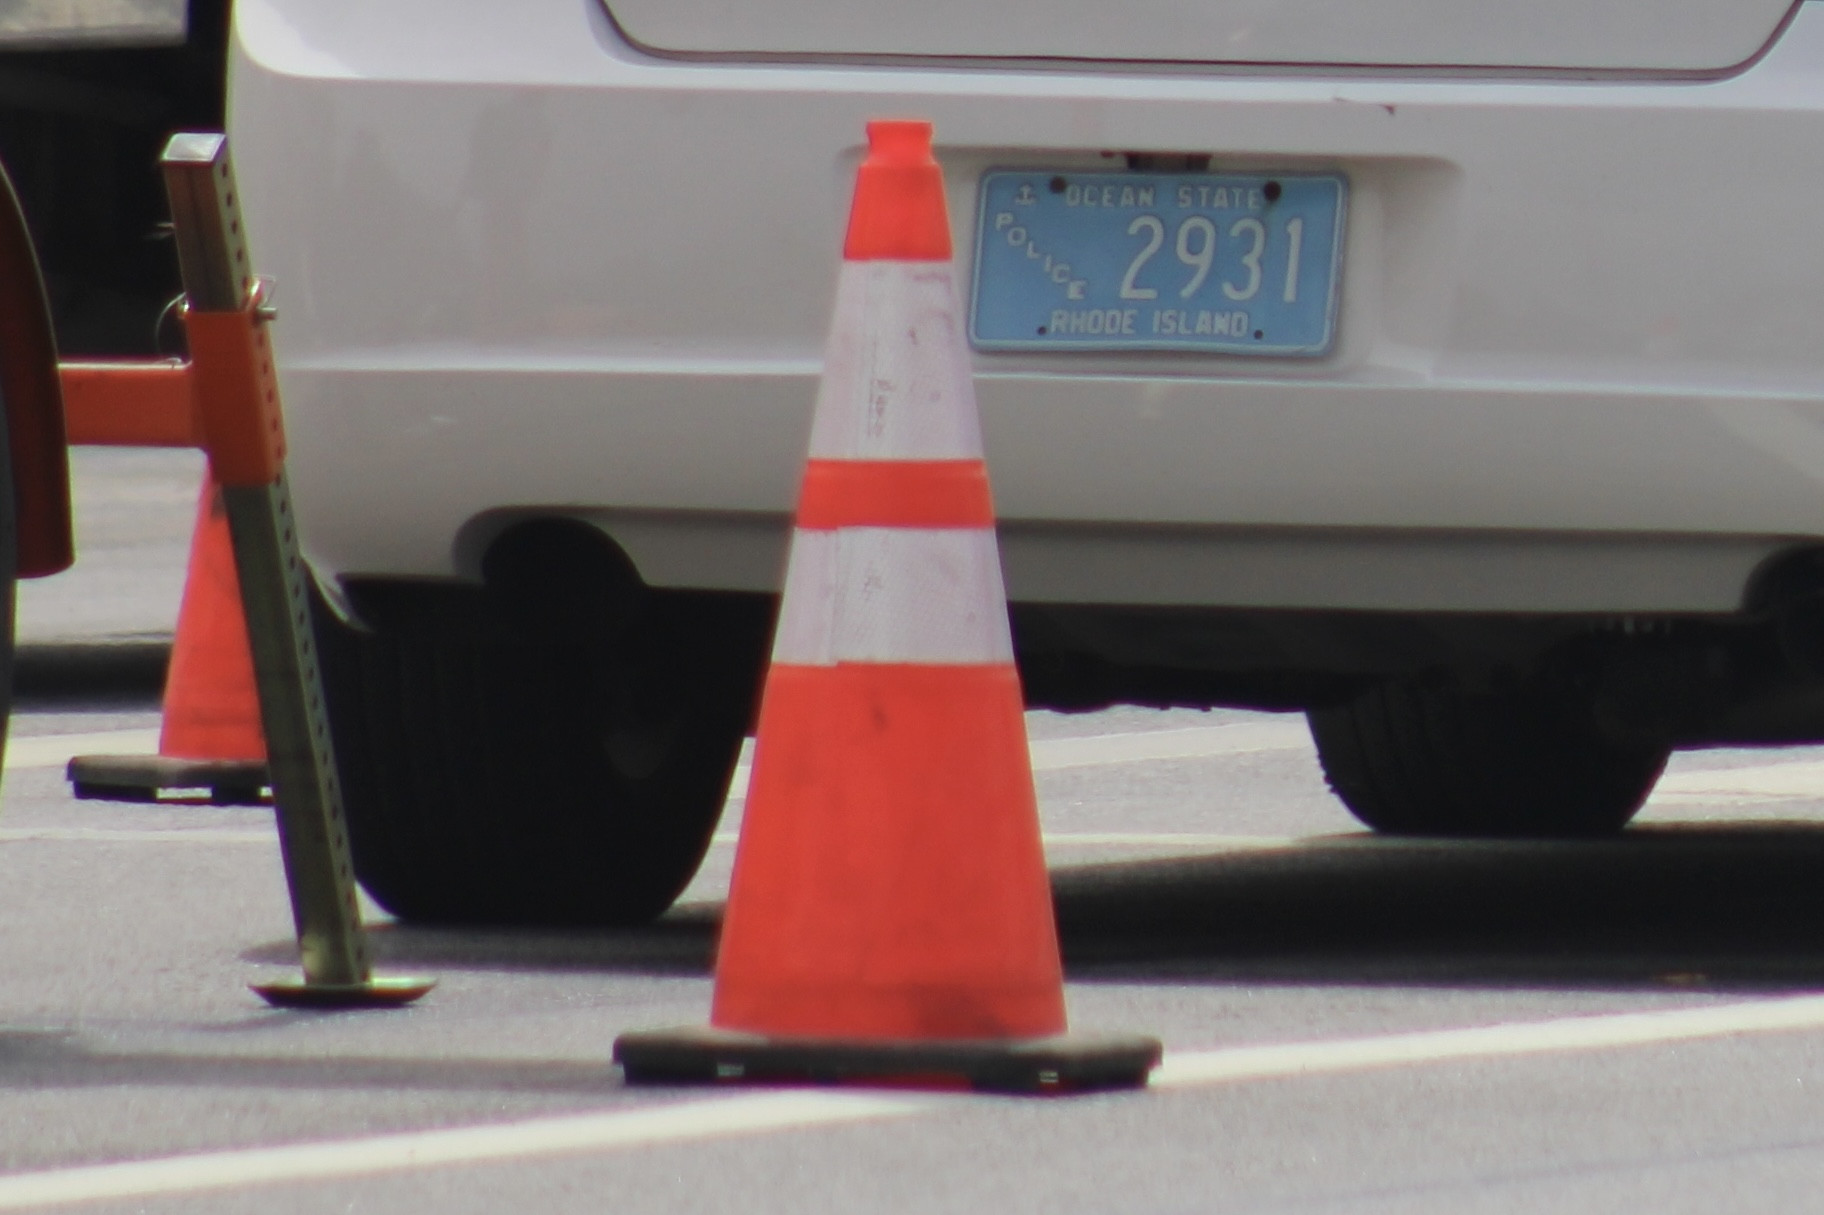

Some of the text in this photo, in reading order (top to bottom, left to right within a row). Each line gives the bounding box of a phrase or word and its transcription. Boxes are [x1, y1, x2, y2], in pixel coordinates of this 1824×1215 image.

[1066, 184, 1262, 210] OCEAN STATE
[994, 211, 1088, 301] POLICE
[1119, 214, 1304, 303] 2931
[1050, 308, 1249, 338] RHODE ISLAND
